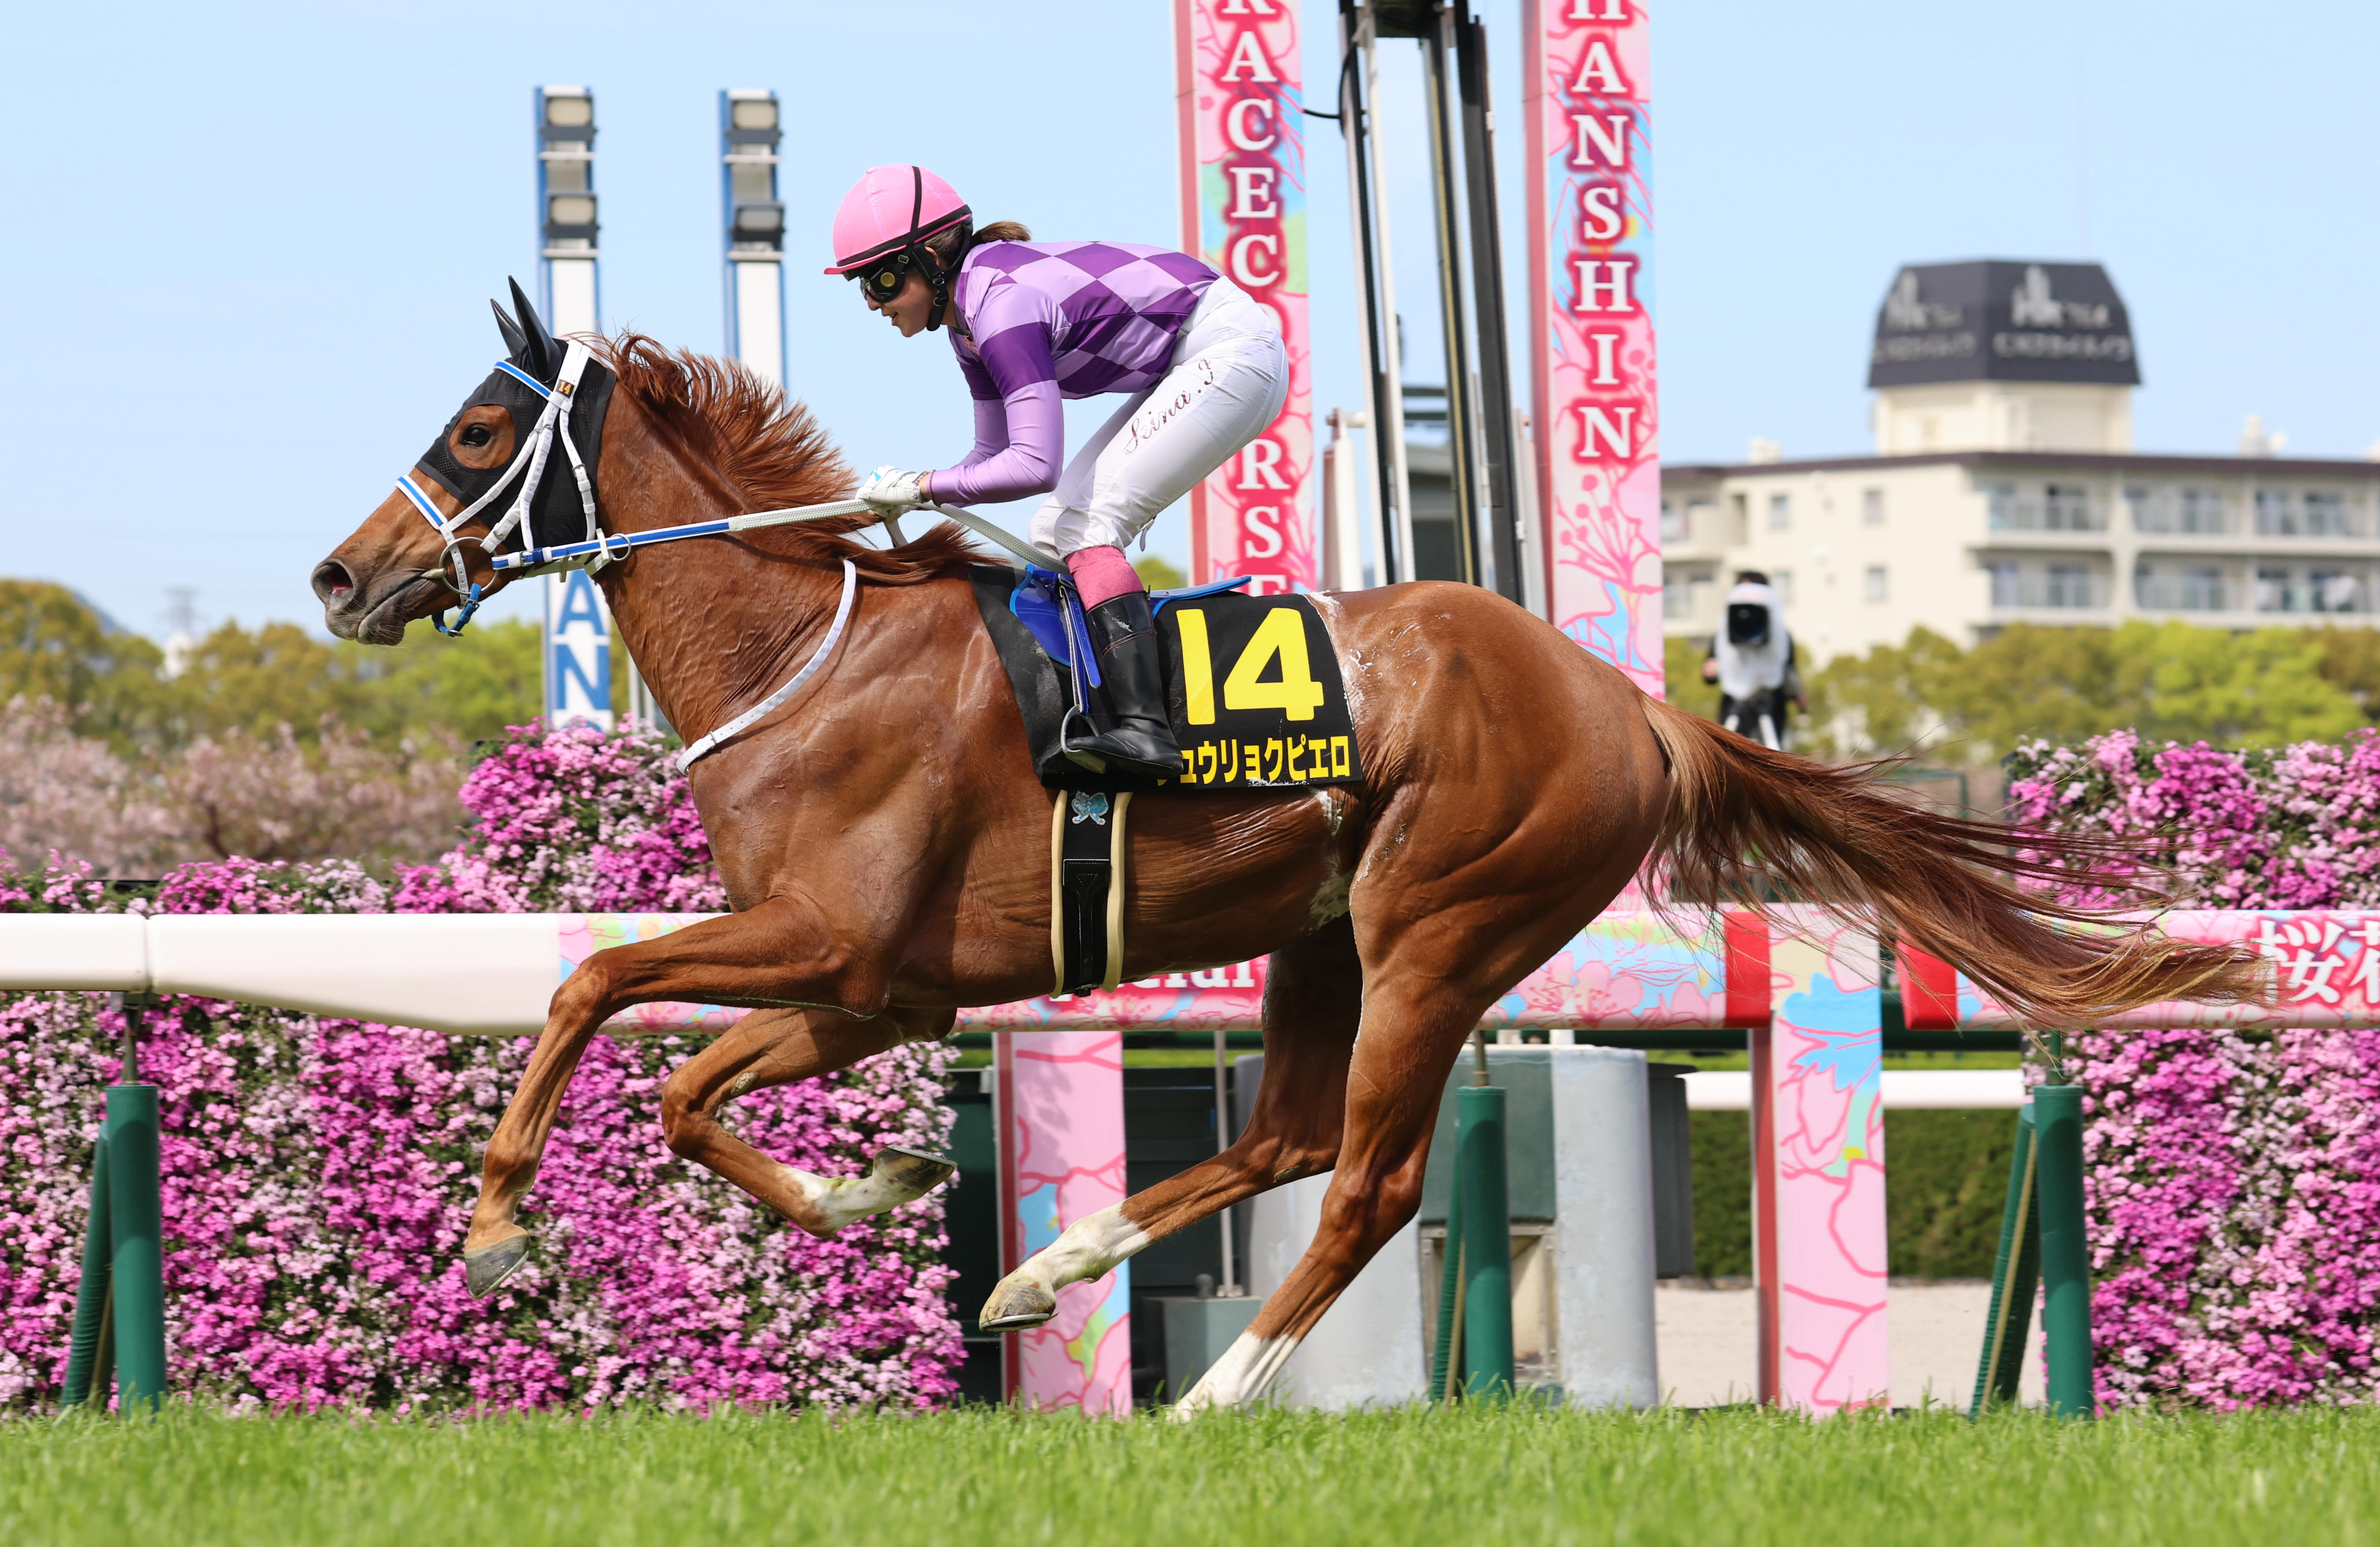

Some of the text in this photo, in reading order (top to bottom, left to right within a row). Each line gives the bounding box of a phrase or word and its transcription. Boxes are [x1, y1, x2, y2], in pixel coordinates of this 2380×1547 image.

[1220, 0, 1290, 597] ACECRS
[559, 381, 571, 395] 14
[556, 569, 610, 732] AN
[1175, 608, 1324, 725] 14
[1157, 734, 1350, 786] ュウリョクピエロ
